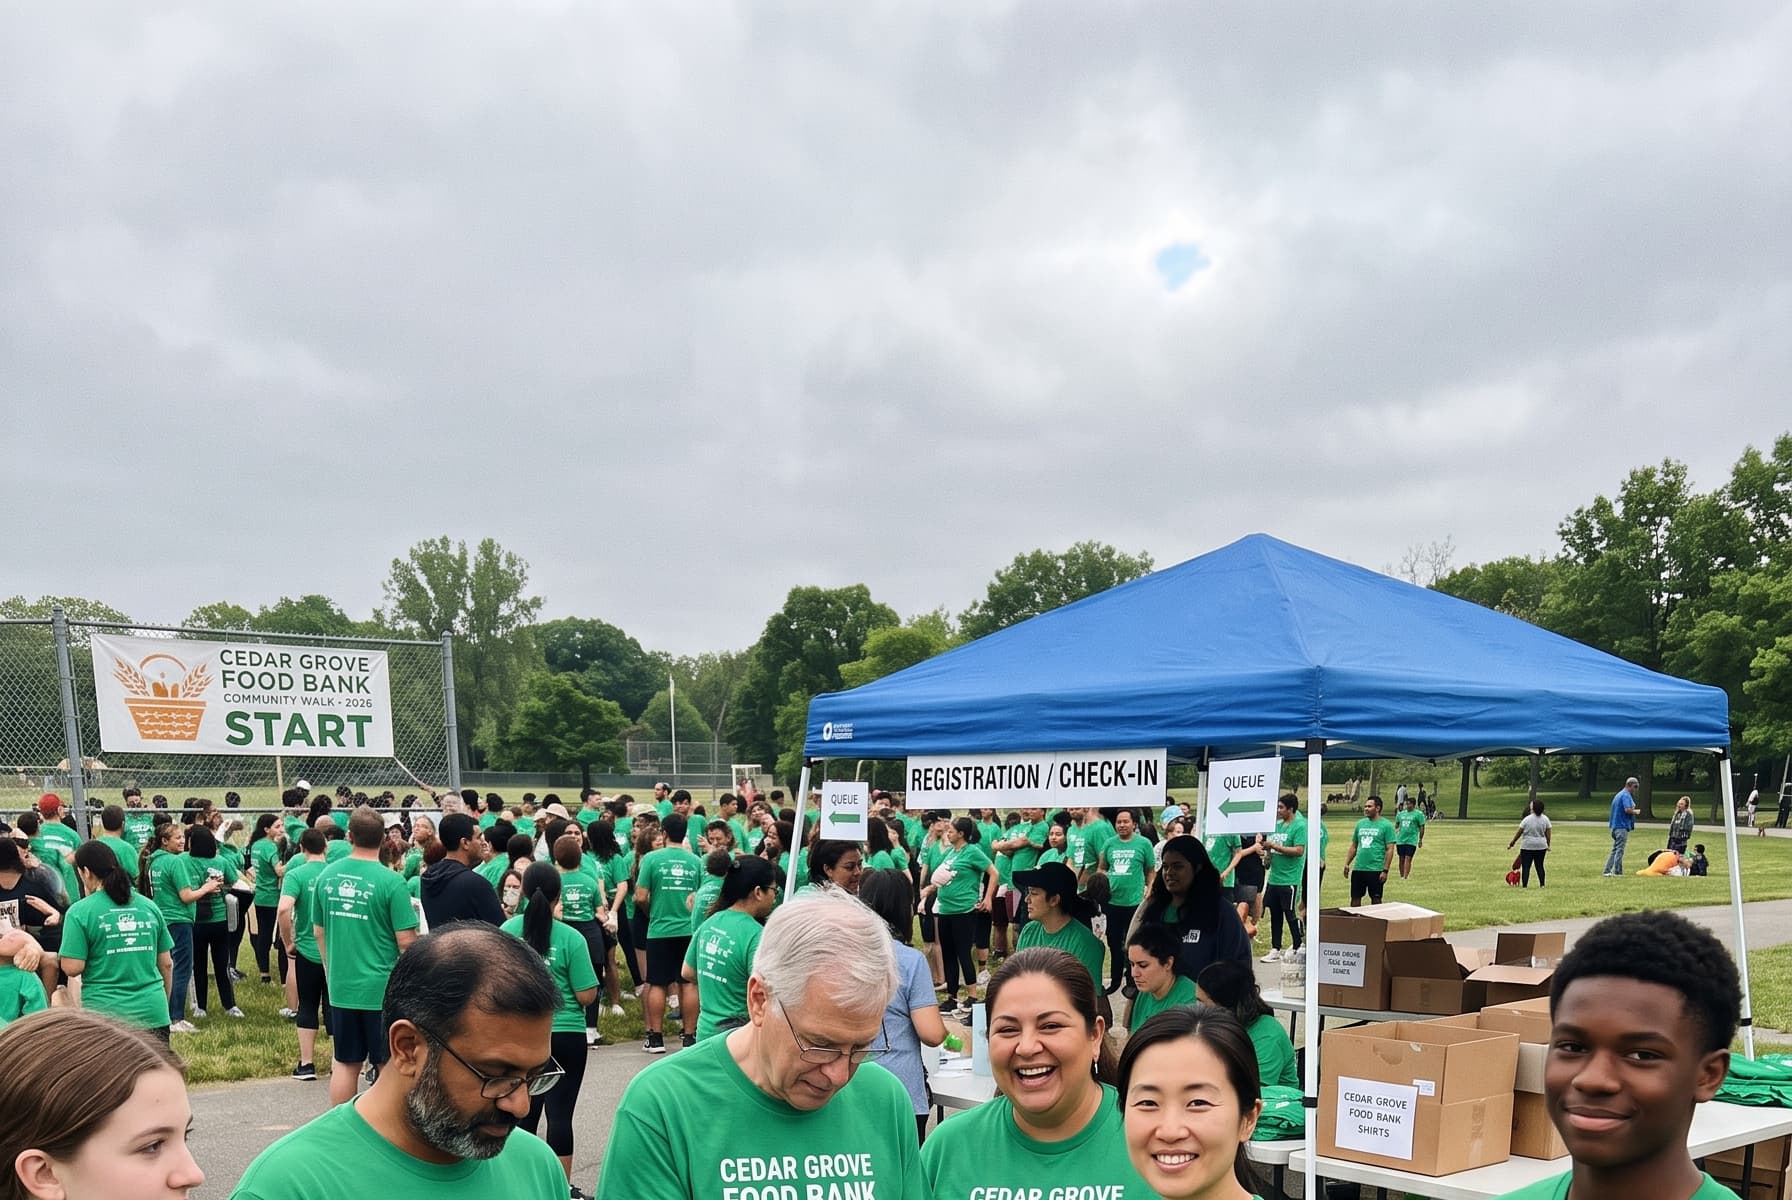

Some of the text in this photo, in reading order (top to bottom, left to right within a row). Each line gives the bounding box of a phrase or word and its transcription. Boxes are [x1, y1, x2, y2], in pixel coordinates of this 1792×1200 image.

[220, 649, 370, 672] CEDAR GROVE
[222, 670, 371, 695] FOOD BANK
[223, 693, 297, 705] COMMUNITY
[300, 696, 335, 707] WALK
[345, 698, 373, 708] 2026
[225, 710, 373, 747] START
[911, 759, 1158, 791] REGISTRATION / CHECK-IN
[1223, 774, 1265, 792] QUEUE
[831, 794, 859, 806] QUEUE
[1344, 1092, 1407, 1110] CEDAR GROVE
[1349, 1108, 1401, 1124] FOOD BANK
[1358, 1124, 1390, 1138] SHIRTS
[720, 1153, 874, 1183] CEDAR GROVE
